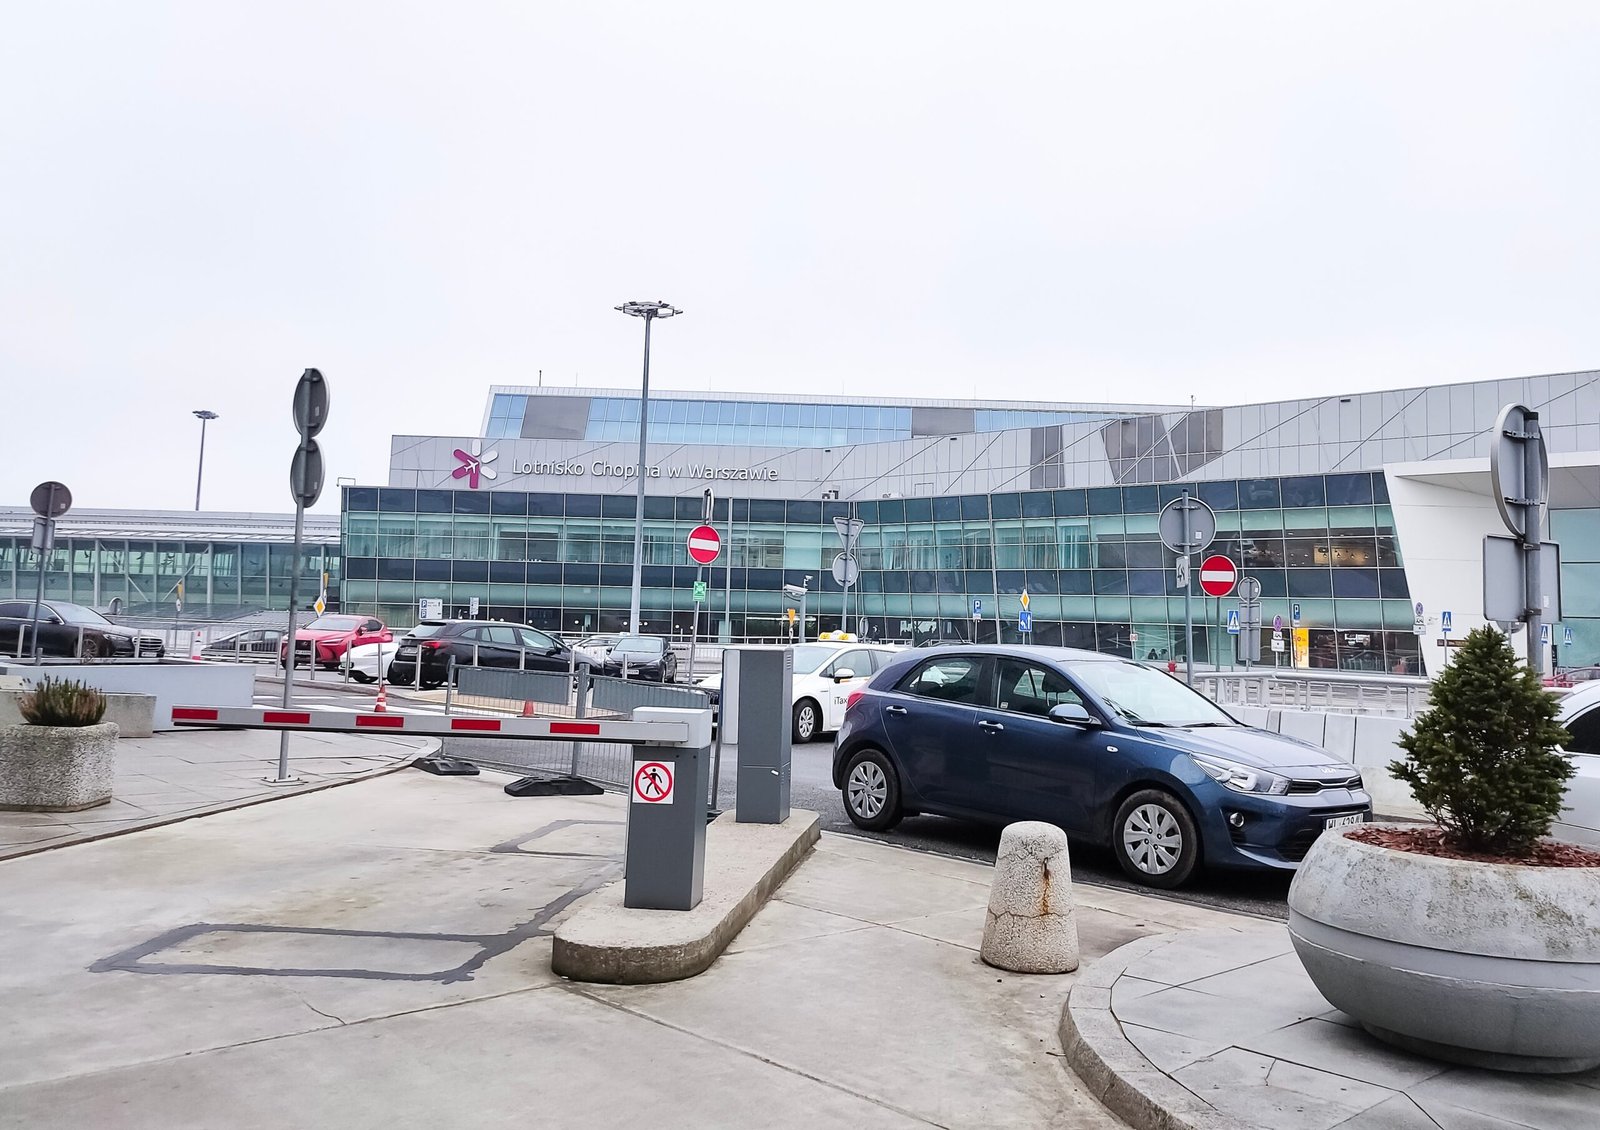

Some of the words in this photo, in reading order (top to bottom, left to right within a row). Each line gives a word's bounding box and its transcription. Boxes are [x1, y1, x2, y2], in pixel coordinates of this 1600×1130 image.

[512, 459, 585, 477] Lotnisko
[591, 461, 661, 480] Chopina
[667, 466, 682, 478] w
[688, 463, 779, 481] Warszawie
[834, 696, 848, 705] iTax
